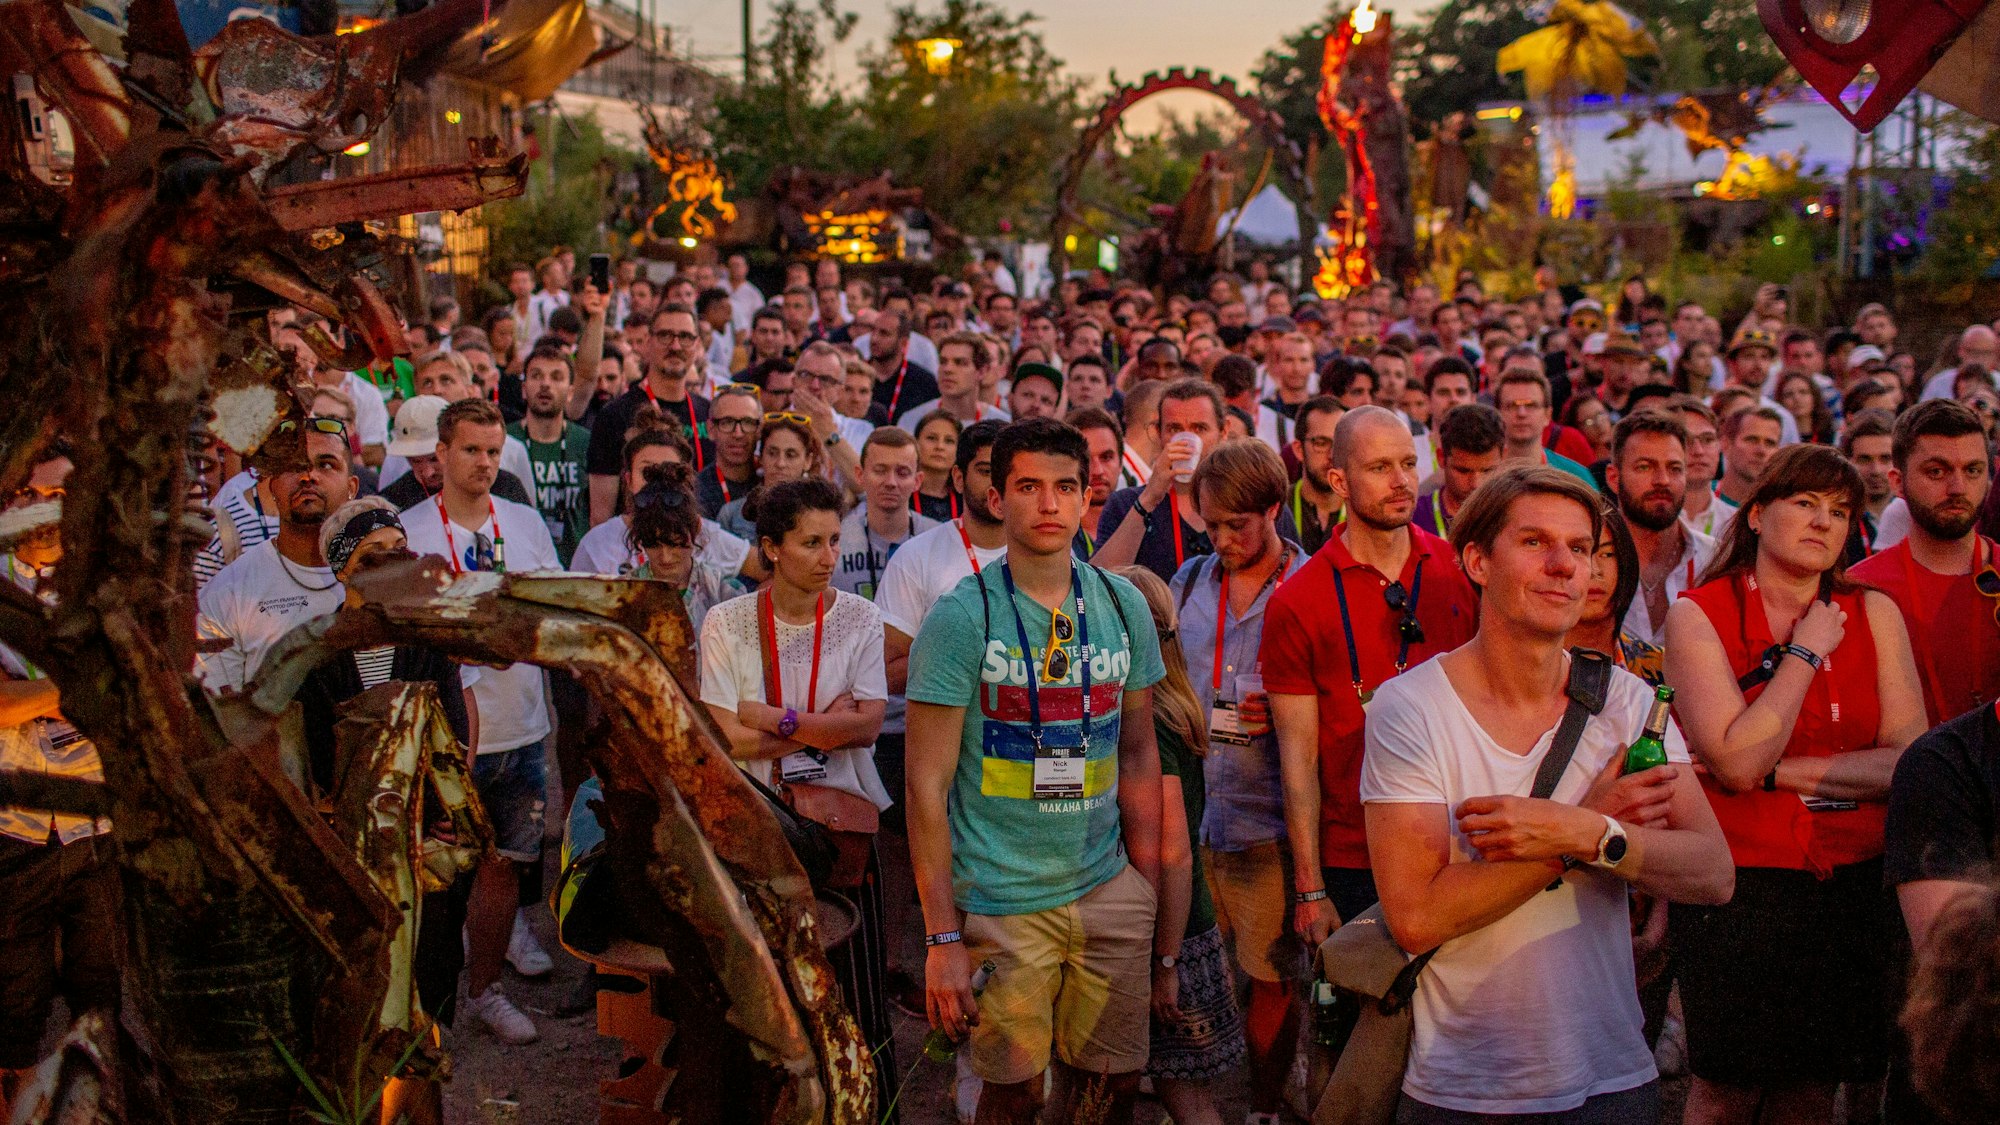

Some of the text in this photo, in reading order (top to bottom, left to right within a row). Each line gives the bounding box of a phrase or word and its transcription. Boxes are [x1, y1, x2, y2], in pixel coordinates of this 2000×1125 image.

[534, 460, 578, 483] RATE
[537, 486, 580, 510] MMIT
[981, 639, 1131, 692] Suprdry
[1083, 694, 1091, 713] PIRATE
[1039, 802, 1081, 813] MAKAHA
